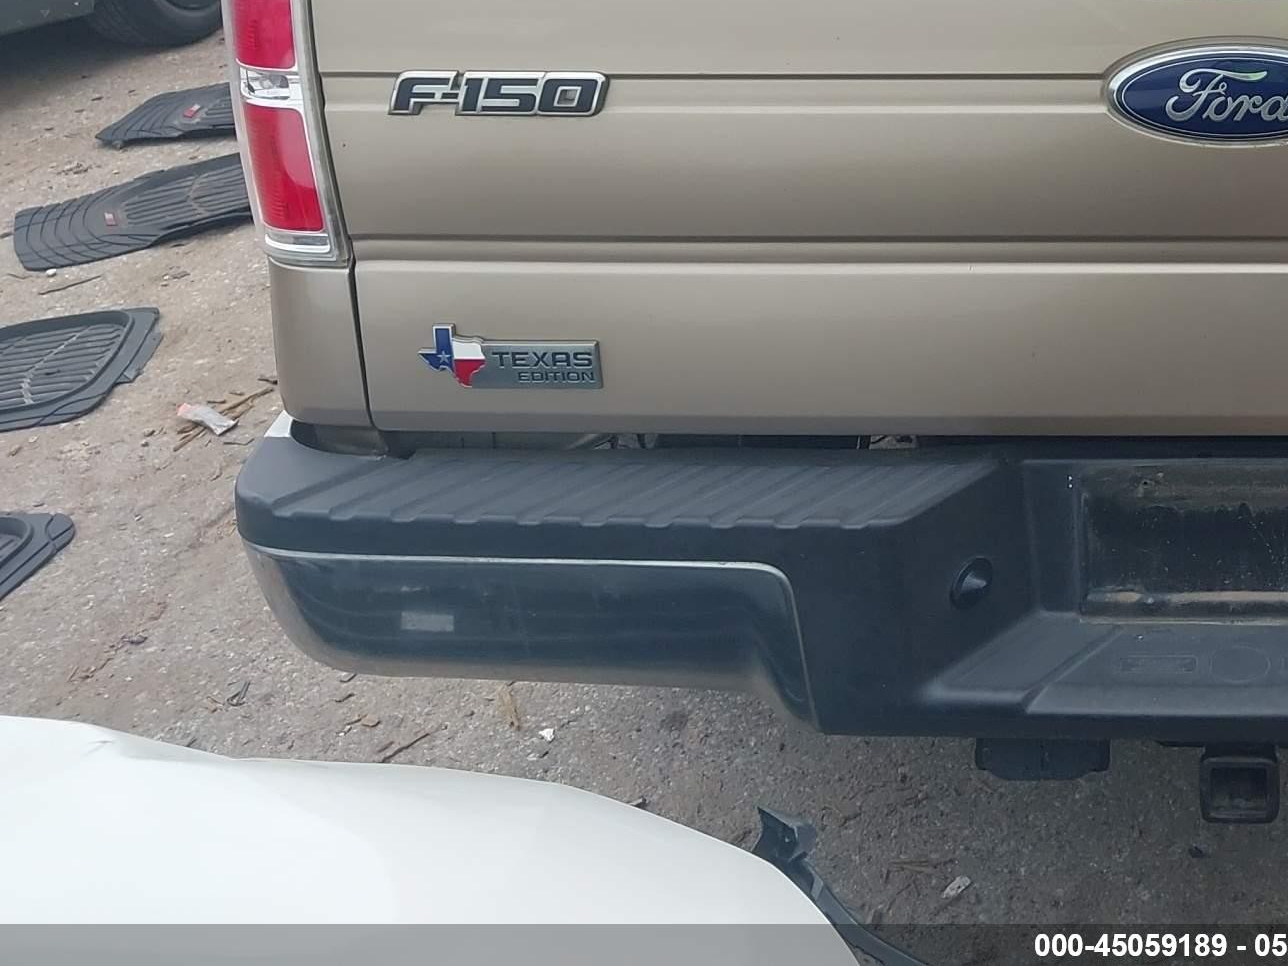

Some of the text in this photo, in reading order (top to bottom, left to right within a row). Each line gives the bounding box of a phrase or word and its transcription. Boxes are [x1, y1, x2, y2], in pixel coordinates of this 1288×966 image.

[388, 70, 609, 117] F-150
[491, 351, 593, 368] TEXAS
[518, 371, 595, 382] EDITION
